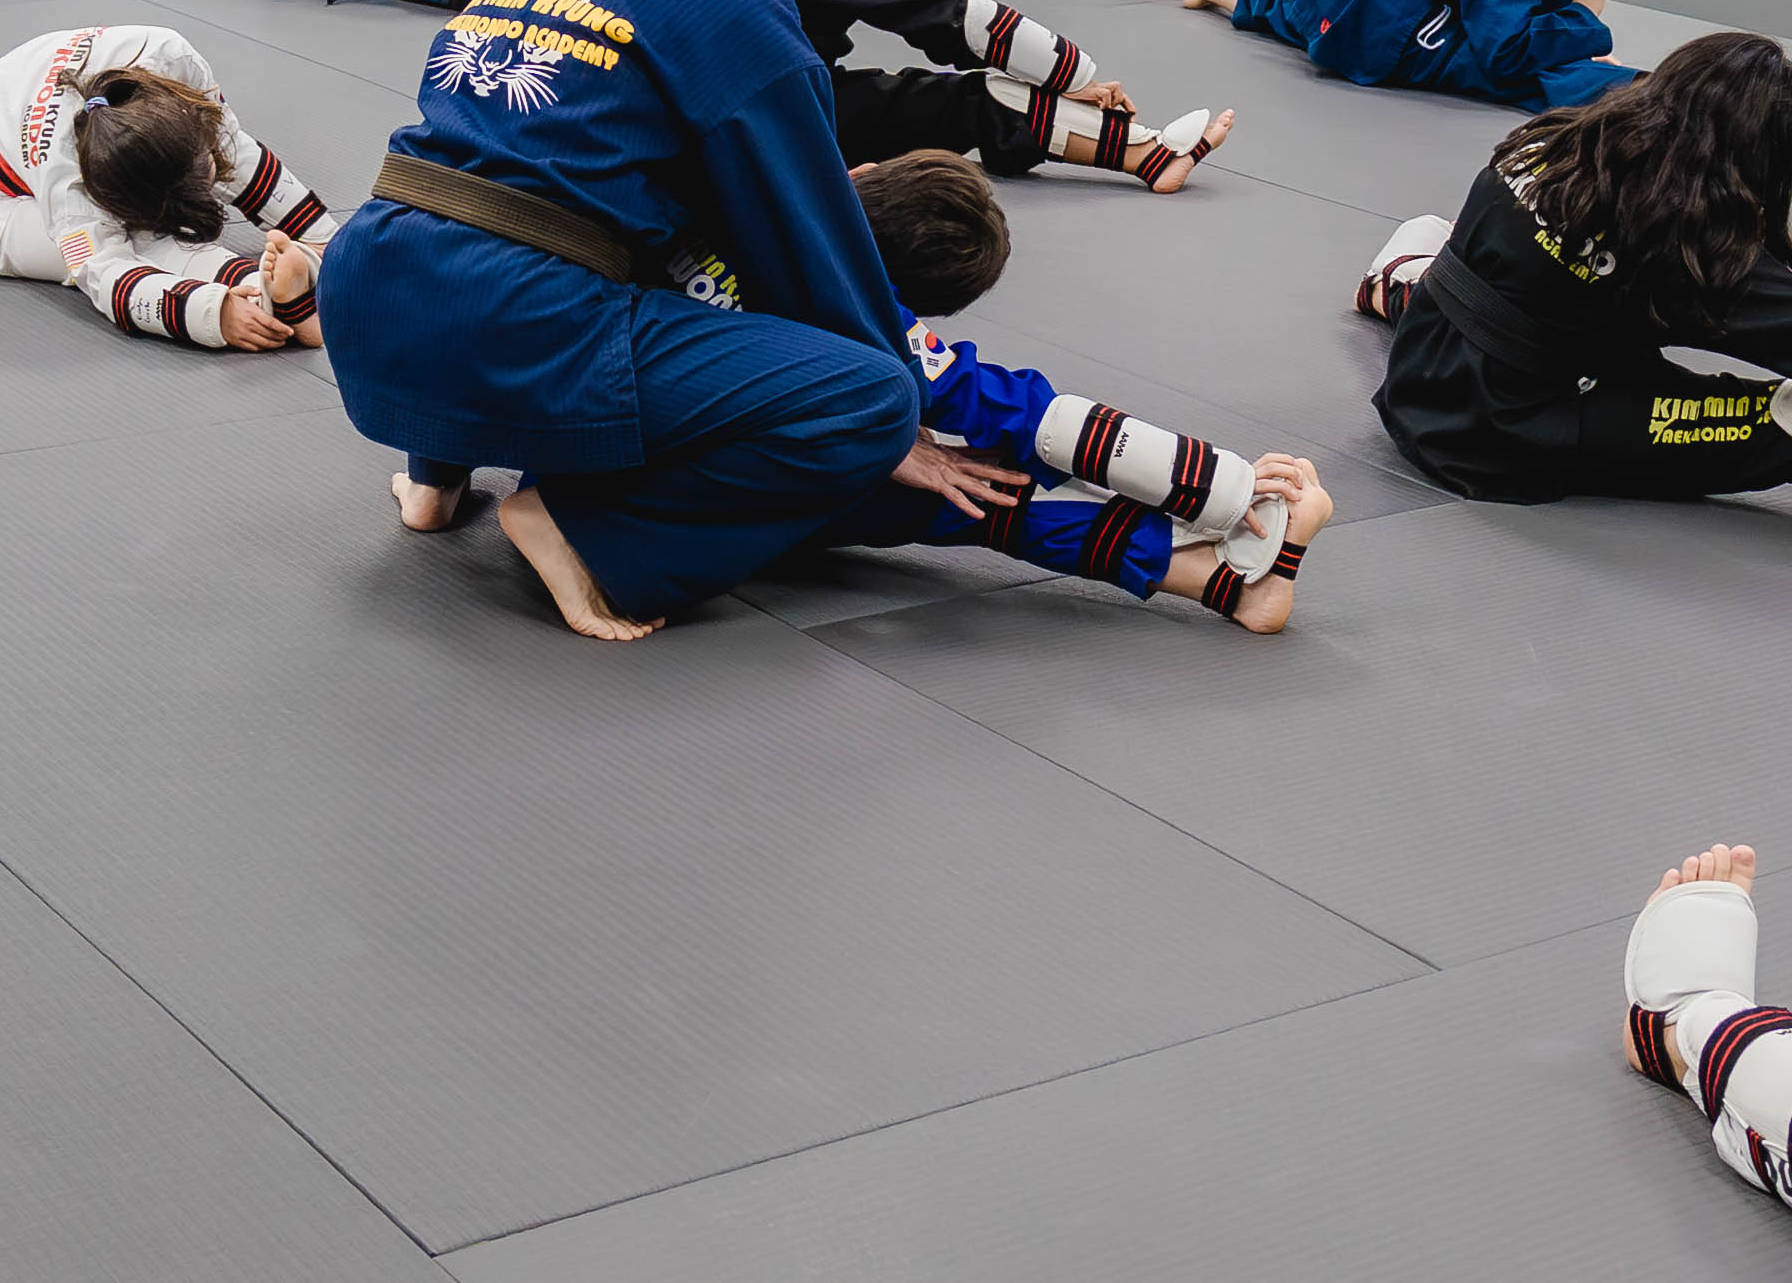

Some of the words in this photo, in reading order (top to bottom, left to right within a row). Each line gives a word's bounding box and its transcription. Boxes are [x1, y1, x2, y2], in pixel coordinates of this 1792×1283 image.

[523, 23, 620, 71] ACADEMY
[1652, 397, 1700, 421] KIM
[1704, 396, 1749, 419] MIN
[1649, 419, 1752, 445] TAEKWONDO
